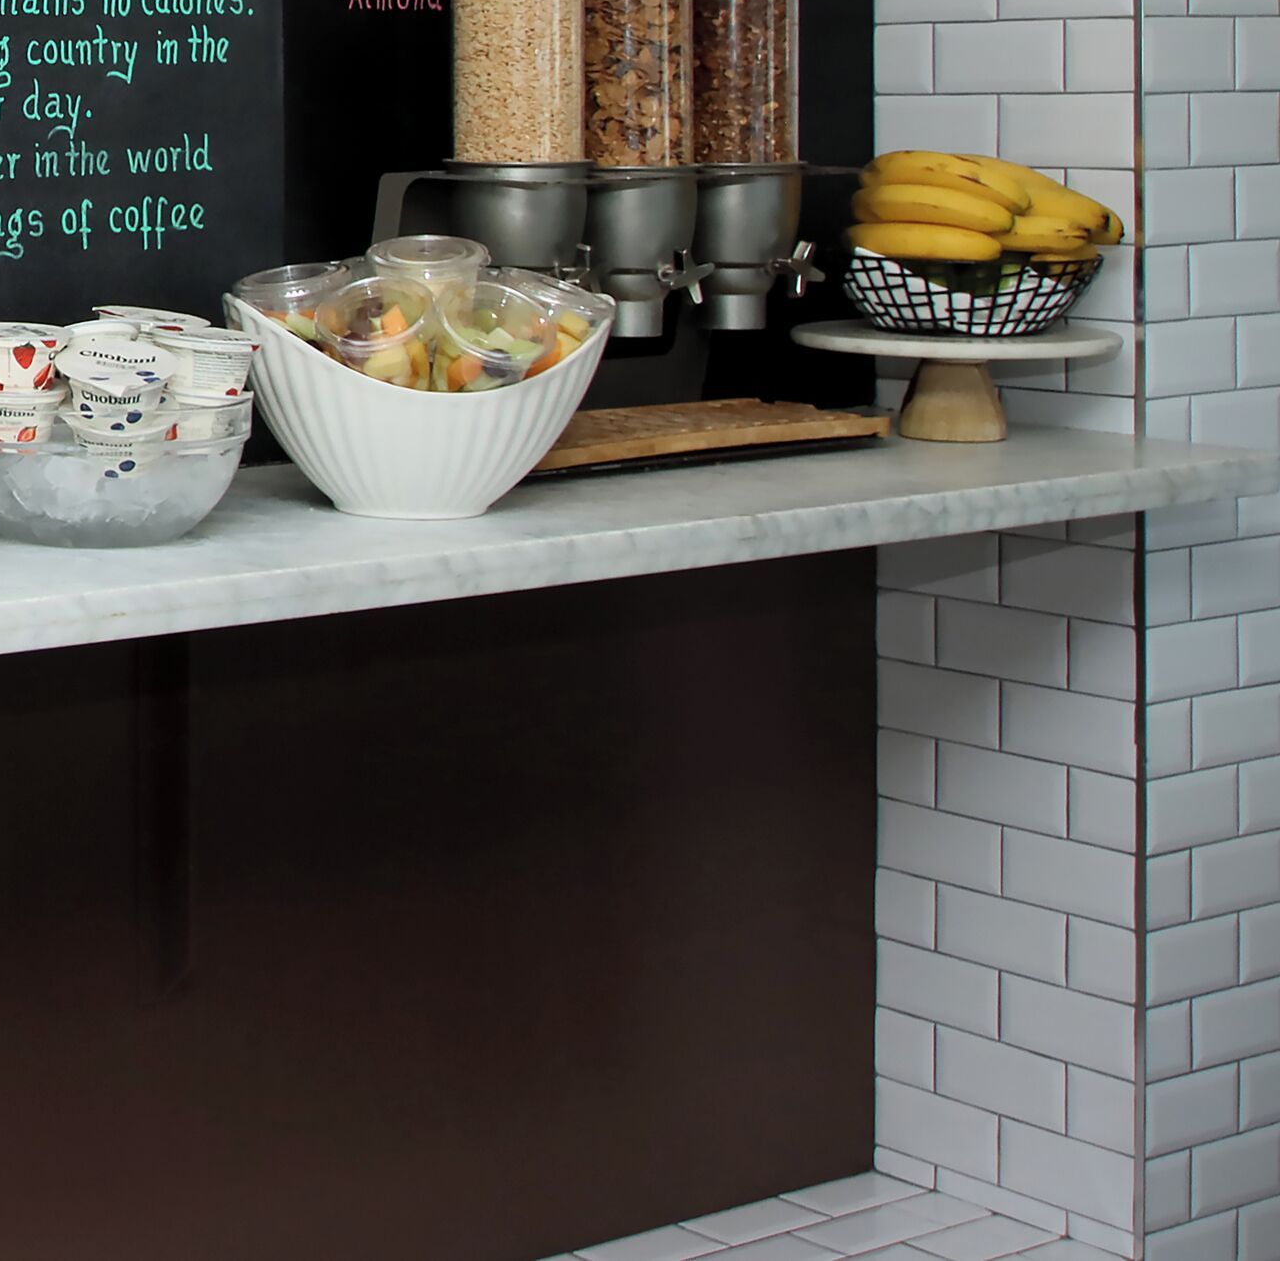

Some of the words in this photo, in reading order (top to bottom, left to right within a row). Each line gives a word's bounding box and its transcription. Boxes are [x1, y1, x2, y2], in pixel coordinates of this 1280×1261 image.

[26, 24, 139, 85] country
[156, 30, 178, 66] in
[190, 24, 230, 65] the
[22, 79, 93, 140] day.
[34, 143, 59, 178] in
[65, 141, 111, 177] the
[127, 133, 214, 174] world
[61, 198, 93, 250] of
[109, 195, 206, 250] coffee
